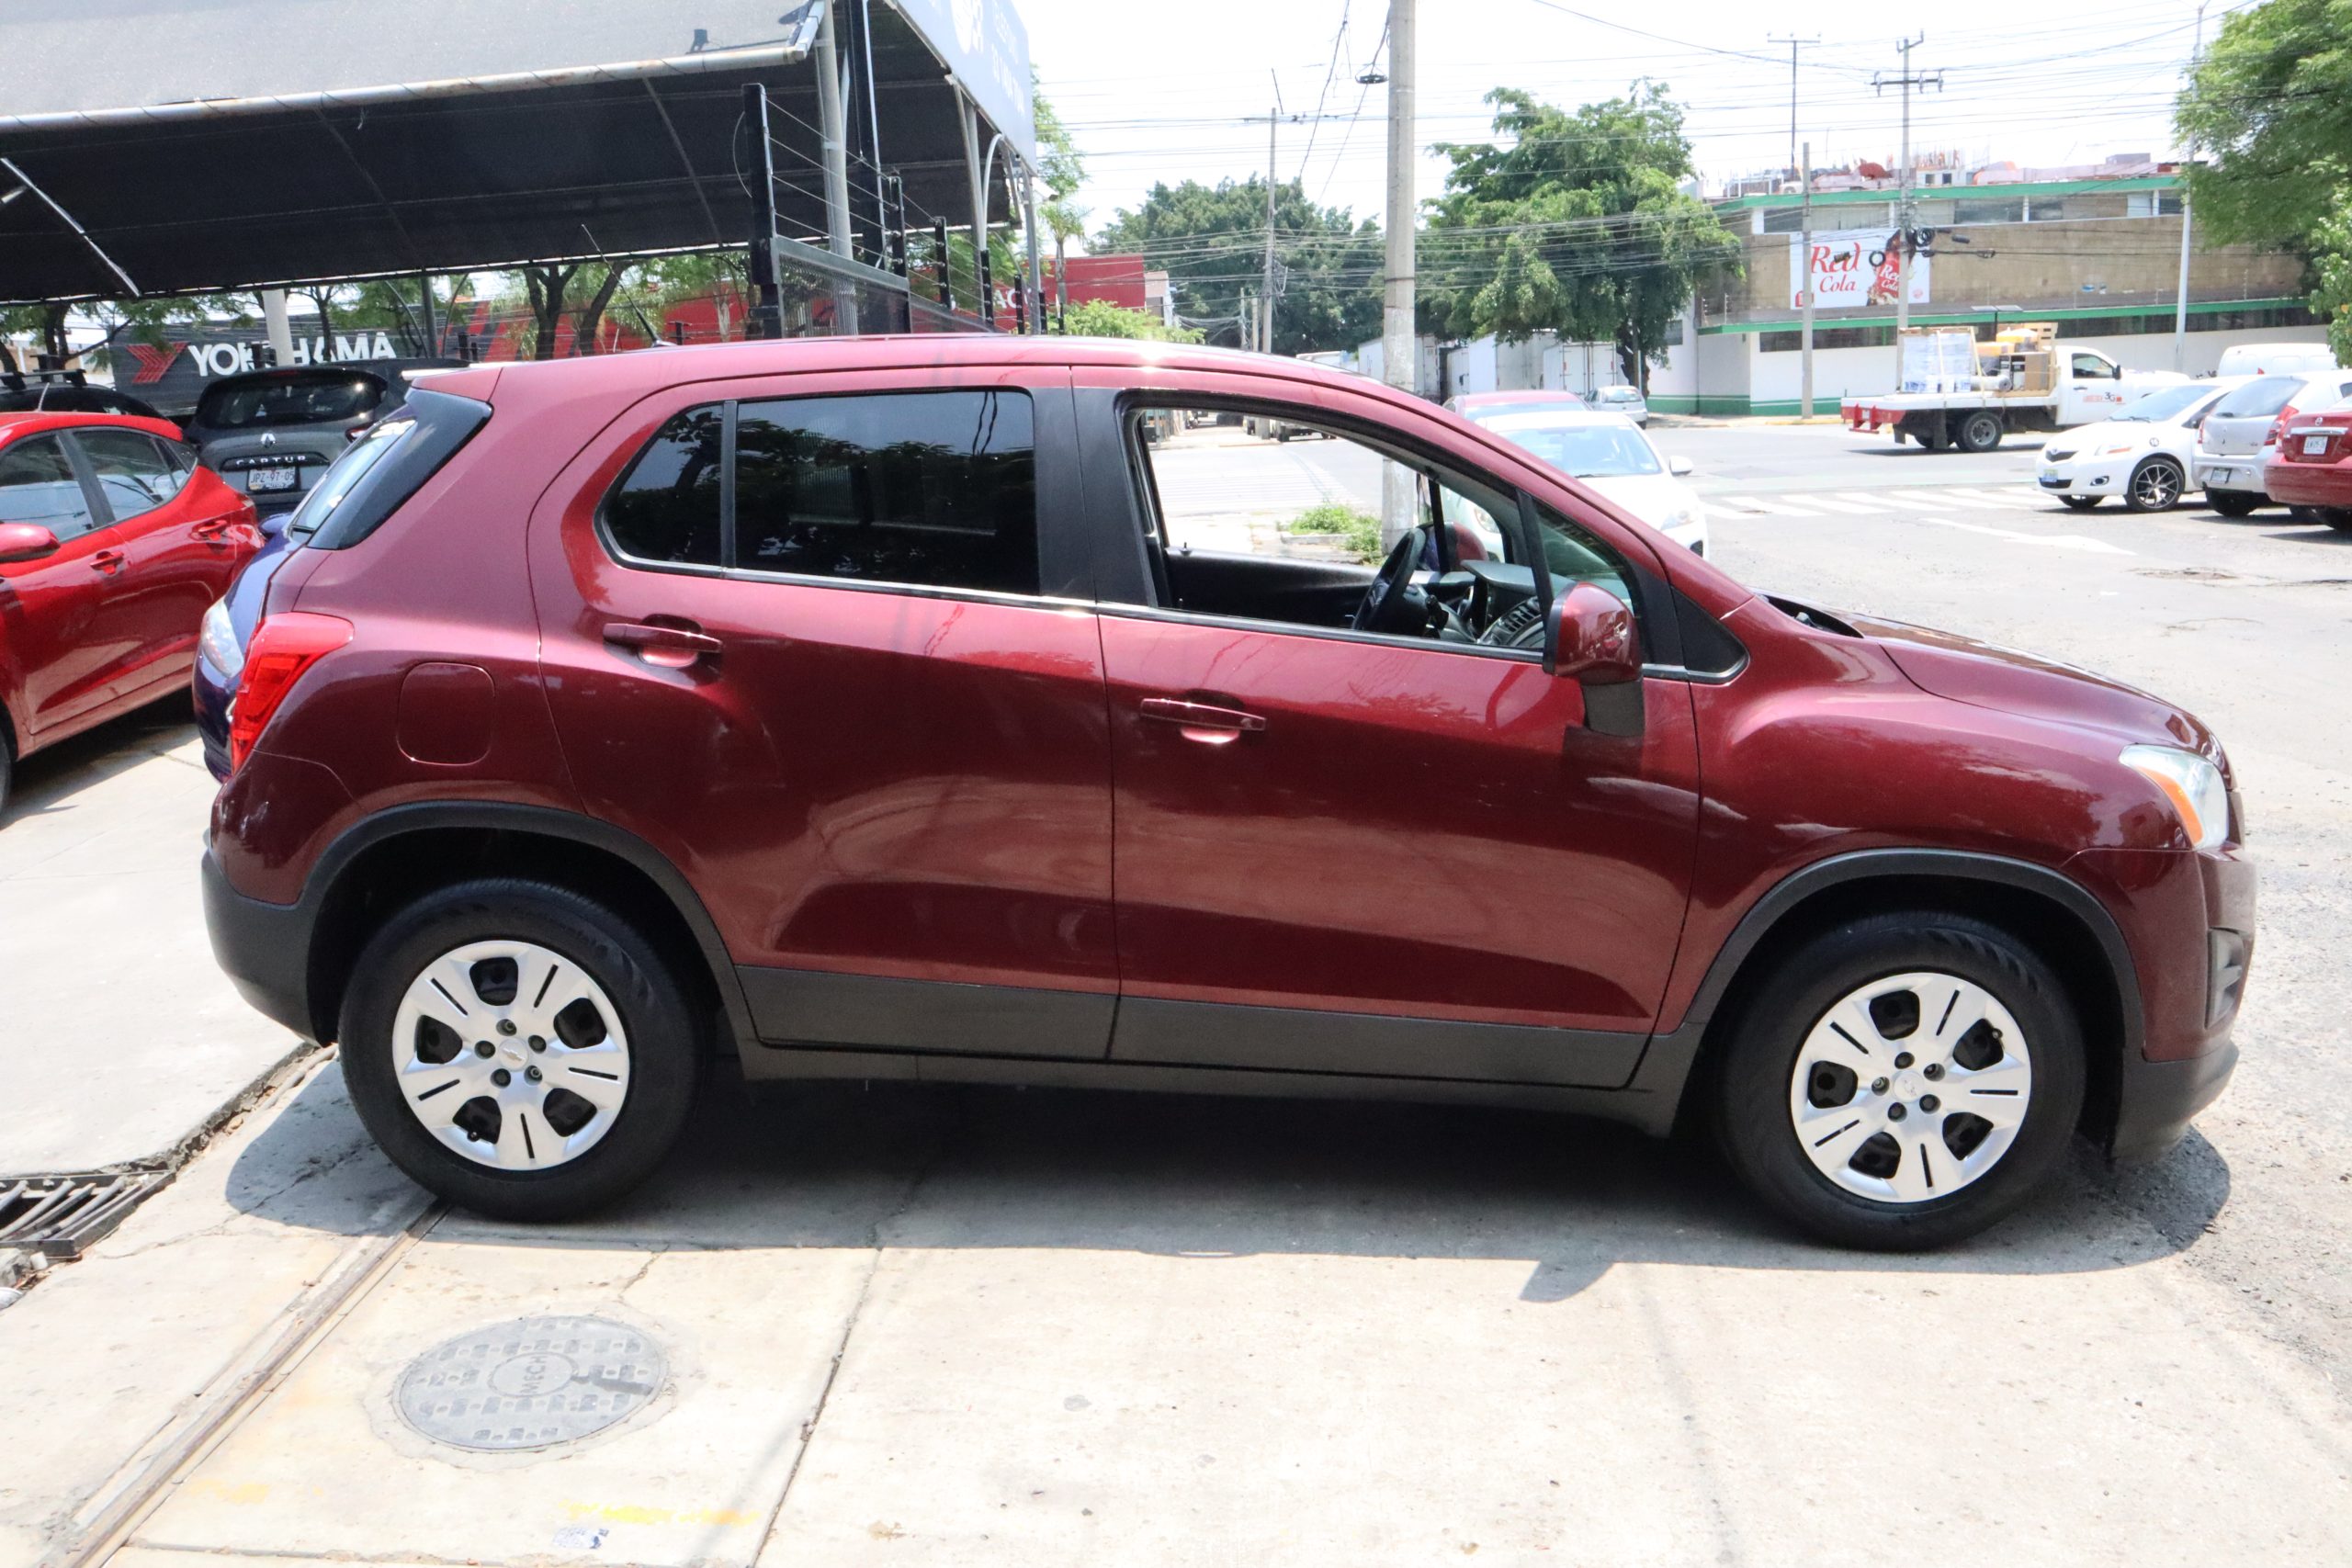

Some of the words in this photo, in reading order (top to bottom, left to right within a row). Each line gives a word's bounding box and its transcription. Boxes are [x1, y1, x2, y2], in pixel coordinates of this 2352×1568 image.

[1820, 274, 1856, 292] Cola
[187, 332, 396, 377] YOKHAMA
[235, 455, 307, 466] CAPTUR
